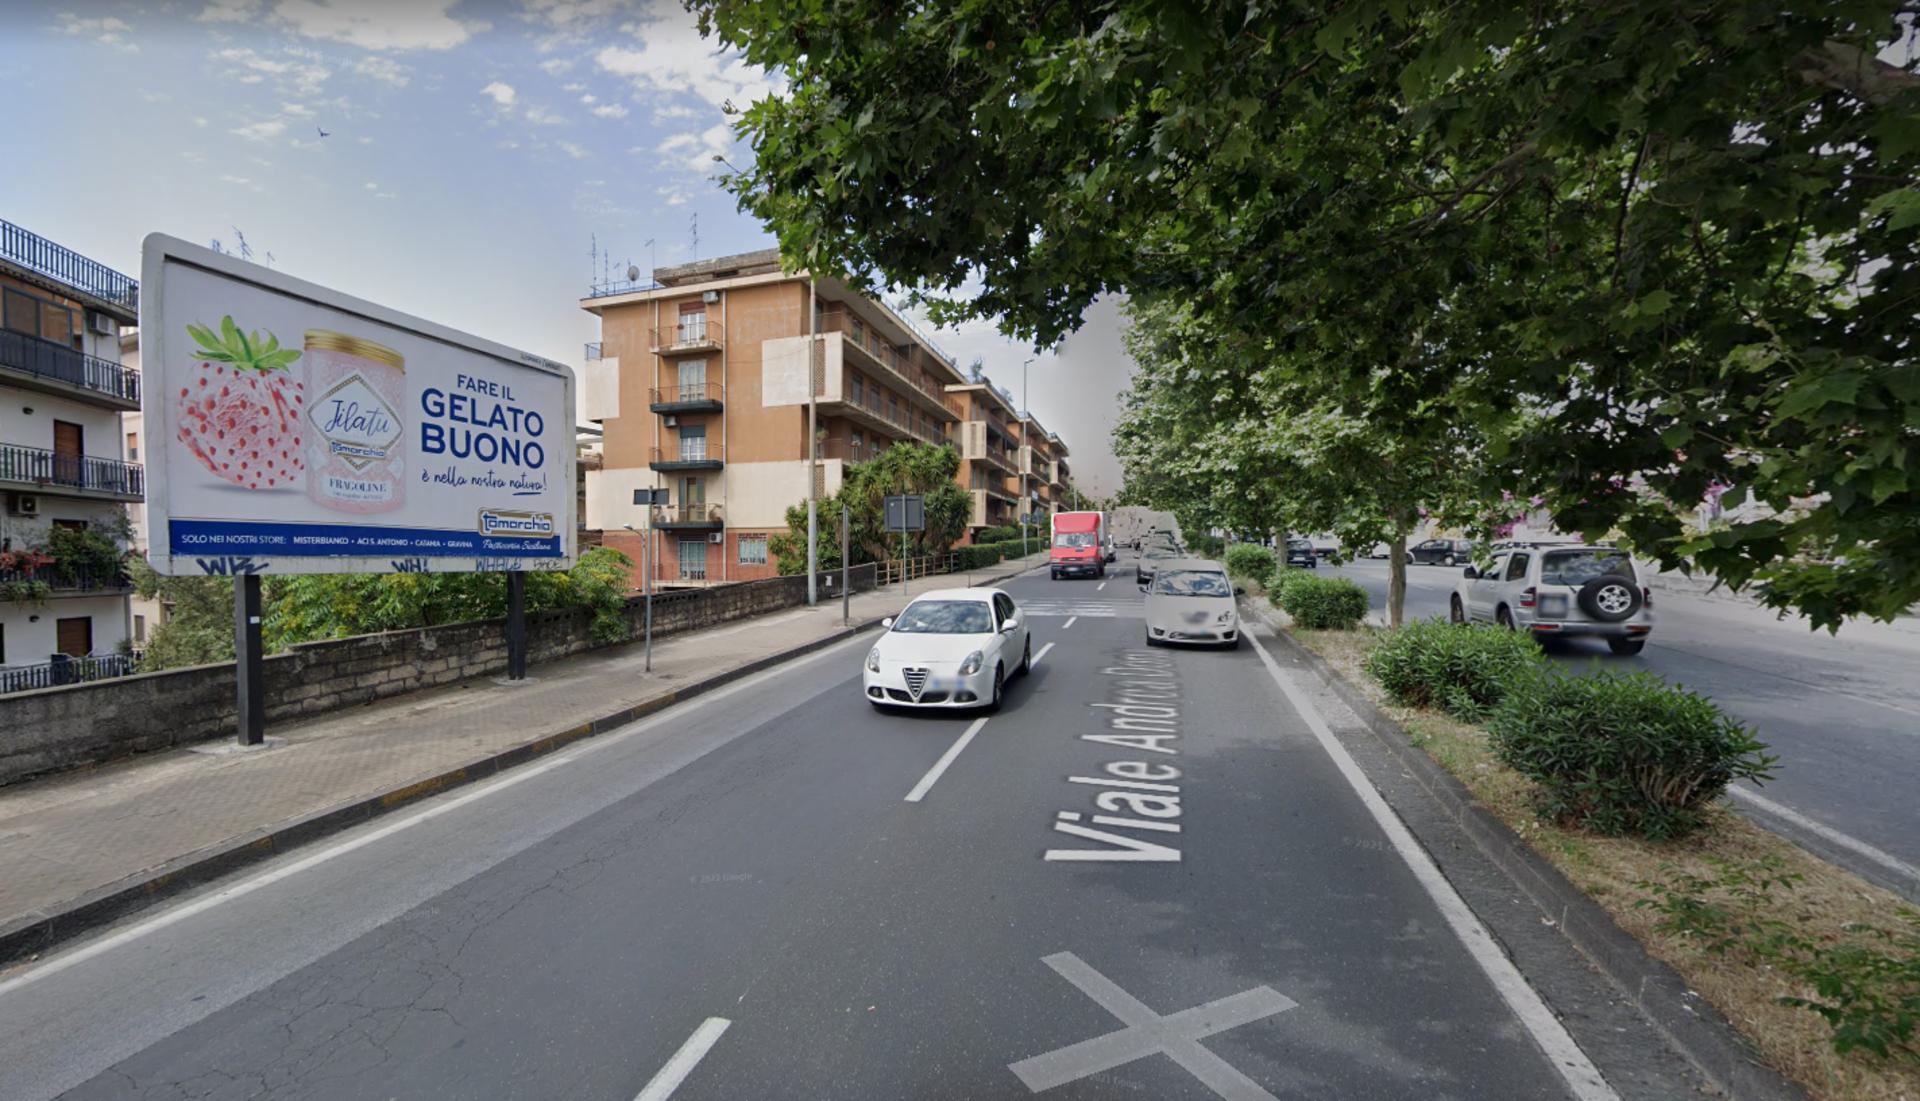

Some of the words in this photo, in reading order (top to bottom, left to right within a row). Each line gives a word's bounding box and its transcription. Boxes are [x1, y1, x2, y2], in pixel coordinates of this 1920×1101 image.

[457, 373, 499, 398] FARE
[502, 385, 516, 402] IL
[421, 387, 544, 437] GELATO
[421, 421, 545, 470] BUONO
[421, 467, 430, 482] è
[433, 466, 467, 488] nella
[471, 468, 507, 489] nostra
[509, 471, 548, 492] natura!
[181, 534, 208, 544] SOLO
[209, 535, 225, 544] NEI
[226, 535, 258, 544] NOSTRI
[259, 535, 287, 545] STORE:
[293, 536, 349, 545] MISTERBIANCO
[357, 537, 369, 545] ACI
[377, 538, 408, 546] ANTONIO
[415, 539, 441, 547] CATANIA
[447, 540, 473, 549] GRAVINA
